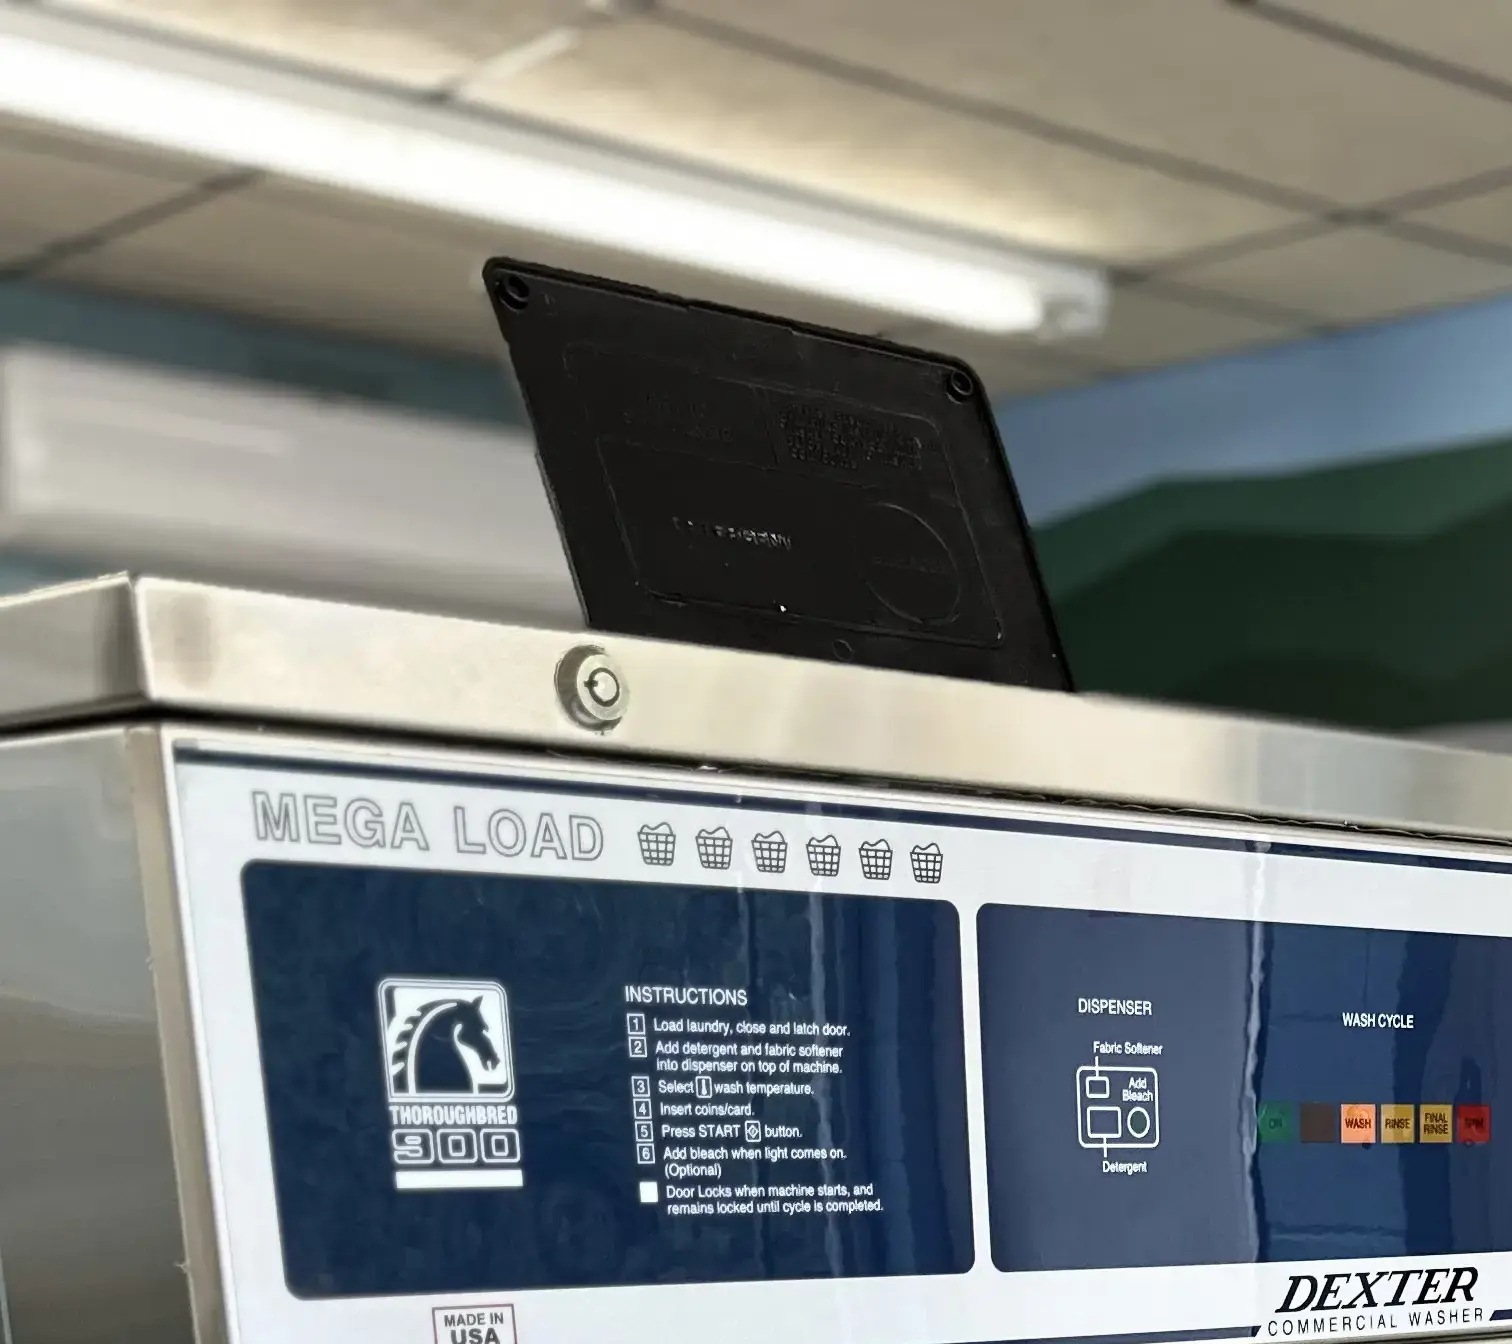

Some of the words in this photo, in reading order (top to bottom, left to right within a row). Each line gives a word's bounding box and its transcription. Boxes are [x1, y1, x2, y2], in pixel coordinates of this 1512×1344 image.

[252, 791, 429, 851] MEGA
[454, 806, 603, 861] LOAD
[625, 986, 747, 1006] INSTRUCTIONS
[1078, 998, 1152, 1015] DISPENSER
[654, 1018, 683, 1032] Load
[687, 1019, 733, 1035] laundry,
[737, 1021, 766, 1033] close
[770, 1021, 789, 1034] and
[794, 1021, 819, 1035] latch
[823, 1023, 850, 1036] door.
[1342, 1012, 1375, 1027] WASH
[1378, 1013, 1414, 1028] CYCLE
[656, 1041, 679, 1054] Add
[683, 1041, 737, 1057] detergent
[741, 1043, 761, 1056] and
[765, 1044, 796, 1056] fabric
[799, 1044, 843, 1057] softener
[1093, 1041, 1122, 1054] Fabric
[1124, 1042, 1163, 1055] Softener
[657, 1060, 678, 1071] into
[682, 1059, 737, 1073] dispenser
[741, 1062, 755, 1072] on
[758, 1060, 775, 1075] top
[779, 1060, 790, 1072] of
[793, 1061, 842, 1073] machine.
[659, 1081, 694, 1093] Select
[714, 1083, 743, 1094] wash
[747, 1083, 814, 1097] temperature.
[1129, 1077, 1146, 1088] Add
[1123, 1089, 1153, 1101] Bleach
[389, 1105, 517, 1125] THOROUGHBRED
[660, 1103, 692, 1115] Insert
[695, 1103, 754, 1116] coins/card.
[1345, 1118, 1371, 1129] WASH
[1385, 1118, 1410, 1129] RINSE
[1425, 1113, 1448, 1123] FINAL
[662, 1125, 695, 1137] Press
[699, 1125, 740, 1137] START
[765, 1125, 802, 1137] button.
[1424, 1125, 1448, 1134] RINSE
[392, 1129, 520, 1164] 900
[664, 1147, 686, 1159] Add
[690, 1147, 728, 1159] bleach
[731, 1147, 761, 1159] when
[765, 1147, 787, 1162] light
[791, 1149, 826, 1158] comes
[830, 1149, 846, 1158] on.
[665, 1164, 721, 1178] (Optional)
[1103, 1161, 1147, 1175] Detergent
[667, 1186, 694, 1197] Door
[698, 1185, 731, 1197] Locks
[735, 1185, 765, 1196] when
[768, 1185, 814, 1196] machine
[818, 1185, 850, 1197] starts,
[854, 1183, 873, 1195] and
[668, 1202, 714, 1214] remains
[717, 1201, 752, 1213] locked
[757, 1201, 779, 1212] until
[783, 1200, 811, 1214] cycle
[814, 1200, 823, 1211] is
[826, 1200, 883, 1214] completed.
[1275, 1267, 1478, 1313] DEXTER
[444, 1313, 486, 1327] MADE
[490, 1312, 503, 1324] IN
[1268, 1314, 1397, 1336] COMMERCIAL
[1409, 1308, 1482, 1326] WASHER
